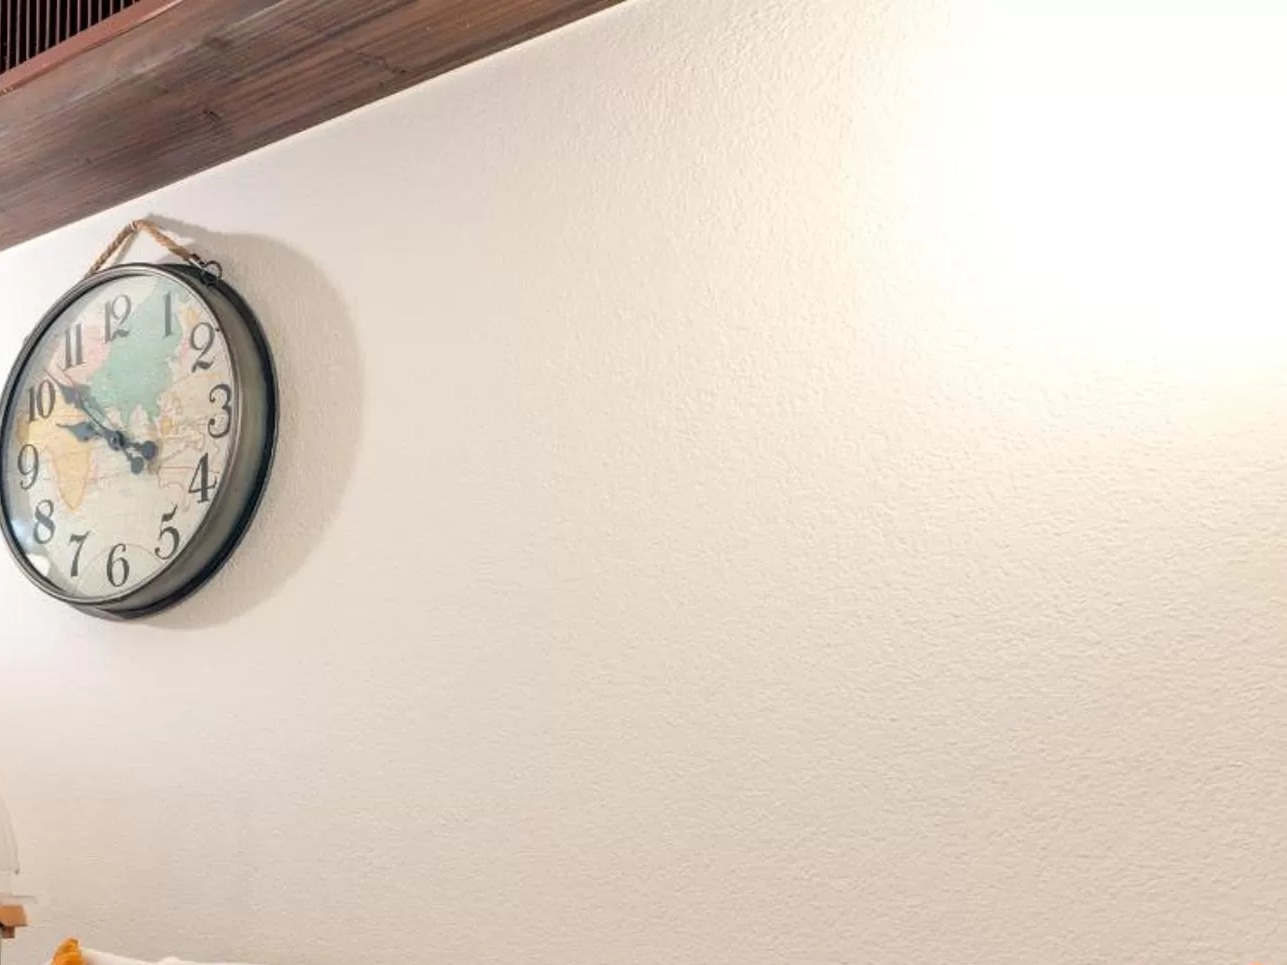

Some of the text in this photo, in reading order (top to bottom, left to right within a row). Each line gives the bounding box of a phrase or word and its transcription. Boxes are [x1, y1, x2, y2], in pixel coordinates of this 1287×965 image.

[104, 294, 132, 343] 12
[161, 291, 174, 340] 1
[62, 323, 85, 370] 11
[190, 322, 216, 373] 2
[28, 379, 56, 422] 10
[207, 384, 233, 438] 3
[17, 444, 40, 490] 9
[188, 452, 217, 504] 4
[32, 499, 56, 545] 8
[155, 504, 181, 560] 5
[68, 530, 91, 578] 7
[106, 543, 130, 587] 6
